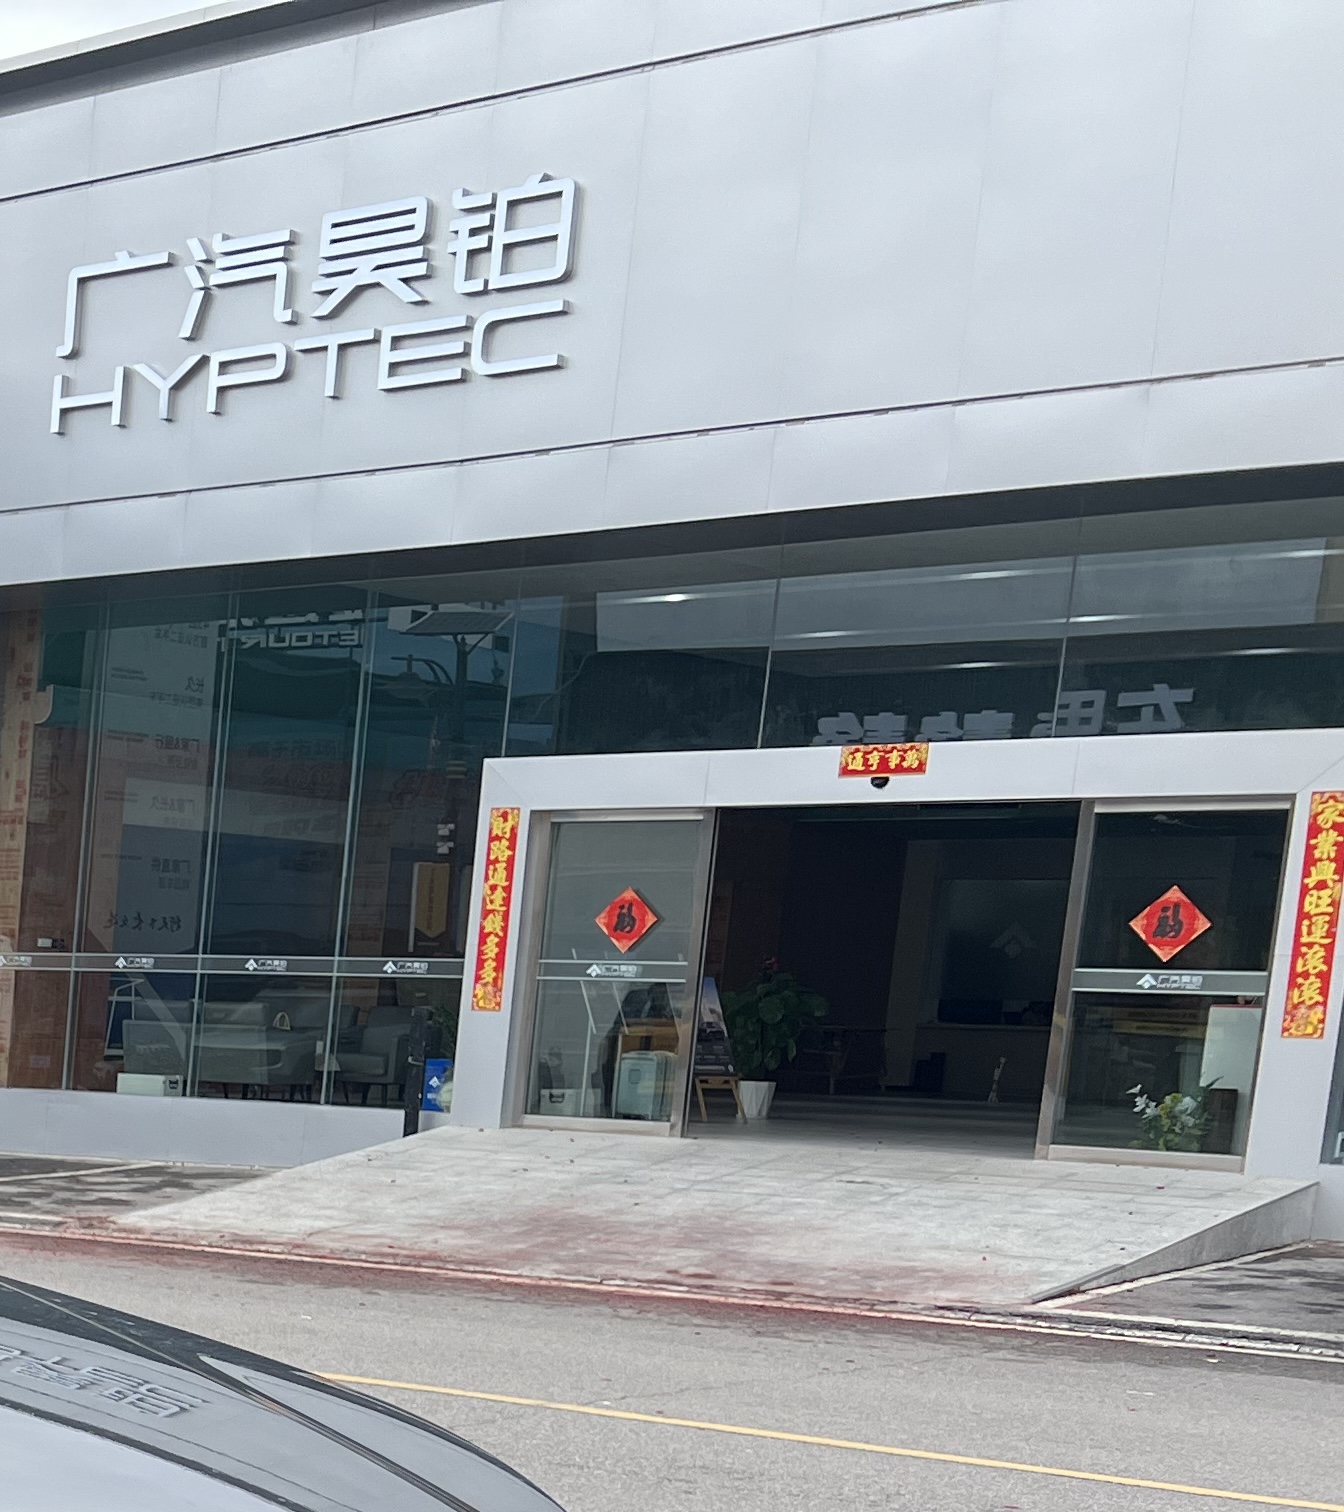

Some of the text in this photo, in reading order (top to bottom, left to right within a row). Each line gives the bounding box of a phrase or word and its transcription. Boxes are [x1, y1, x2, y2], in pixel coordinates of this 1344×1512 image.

[55, 172, 582, 359] 广汽昊铂
[49, 299, 570, 435] HYPTEC
